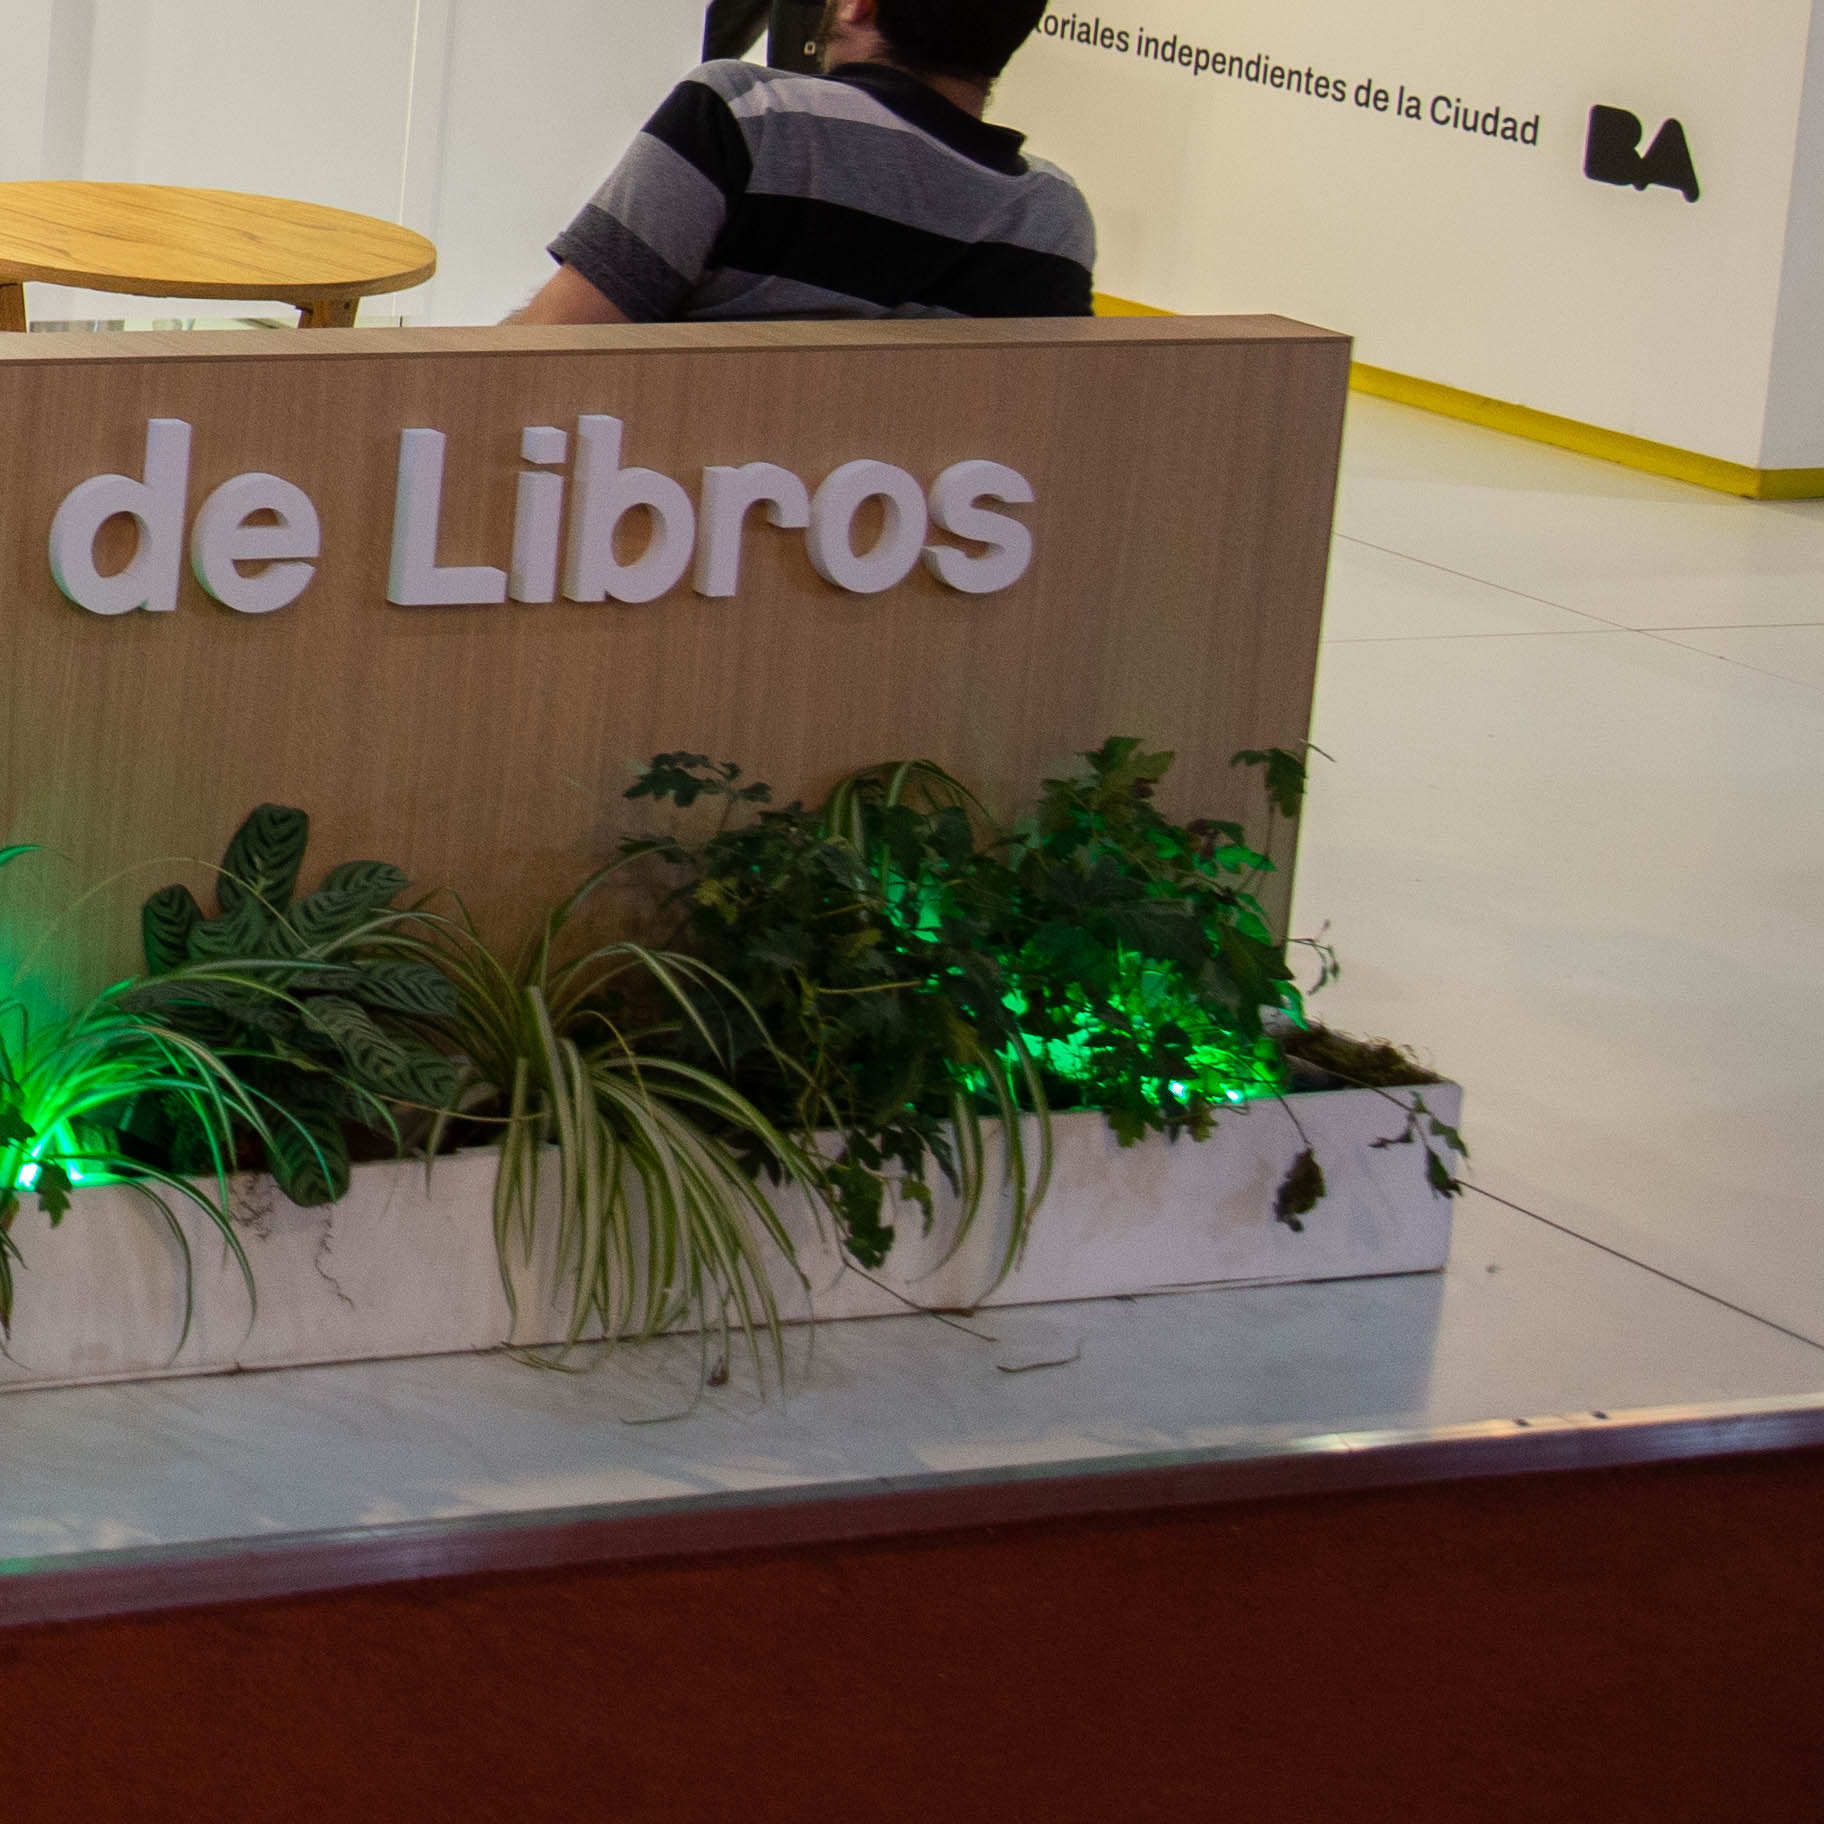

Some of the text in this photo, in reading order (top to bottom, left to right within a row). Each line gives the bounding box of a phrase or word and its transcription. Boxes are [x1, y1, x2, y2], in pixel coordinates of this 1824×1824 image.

[1034, 13, 1542, 148] oriales independientes de la Ciudad
[1583, 103, 1701, 204] BA
[45, 415, 322, 616] de
[385, 412, 1037, 609] Libros
